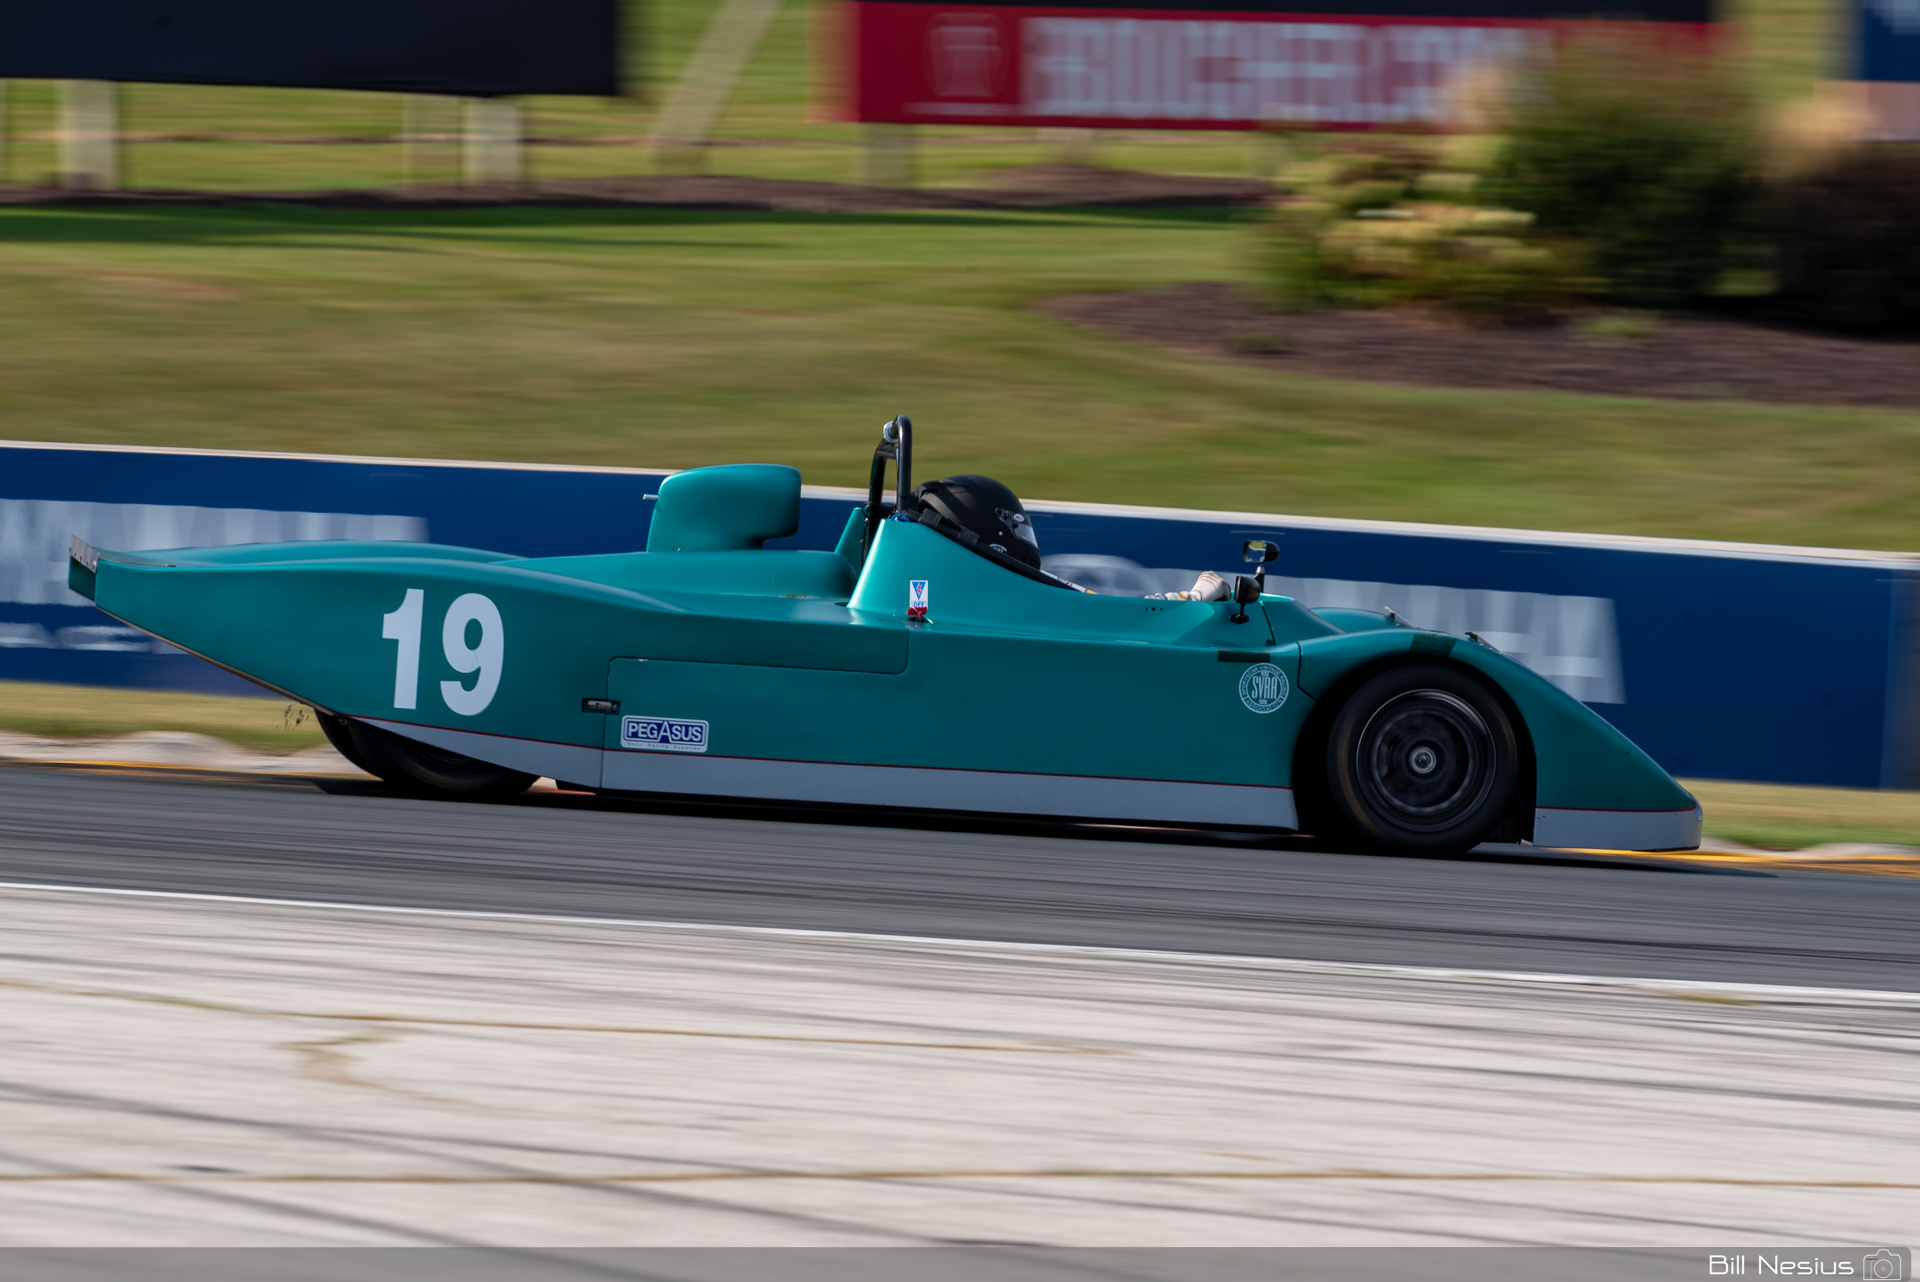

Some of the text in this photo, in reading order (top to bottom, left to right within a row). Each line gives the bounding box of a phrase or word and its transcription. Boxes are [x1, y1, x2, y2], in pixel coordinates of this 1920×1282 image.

[382, 588, 504, 716] 19
[1260, 665, 1280, 675] VINTAGE
[1251, 675, 1278, 699] SVRA
[1245, 699, 1283, 711] ASSOCIATION
[628, 720, 702, 742] PEGASUS
